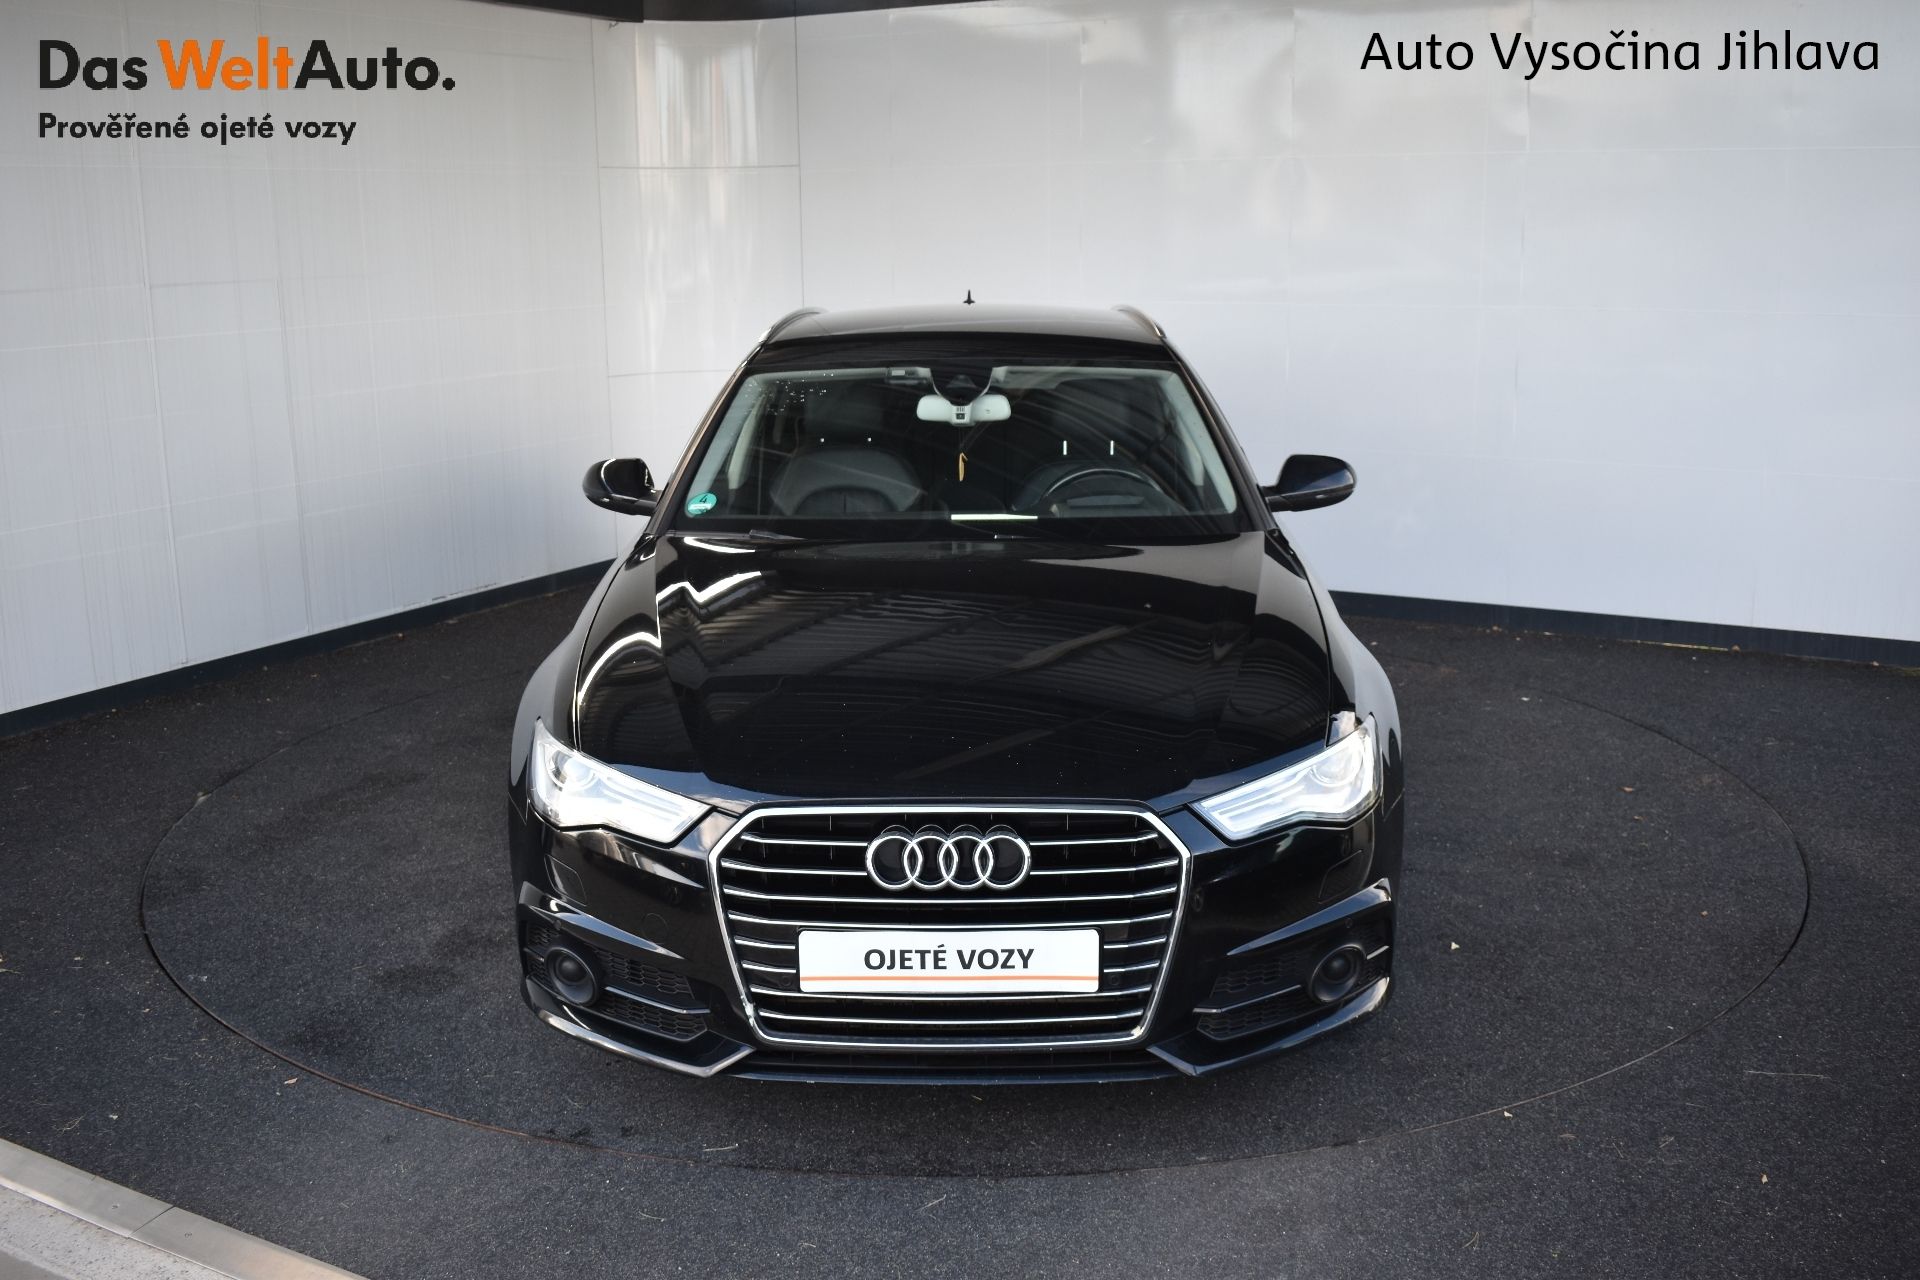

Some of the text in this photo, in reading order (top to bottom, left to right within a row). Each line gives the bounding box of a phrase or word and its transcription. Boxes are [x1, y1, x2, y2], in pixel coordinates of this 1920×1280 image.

[699, 494, 708, 504] 4
[864, 943, 1035, 970] OJETÉ VOZY
